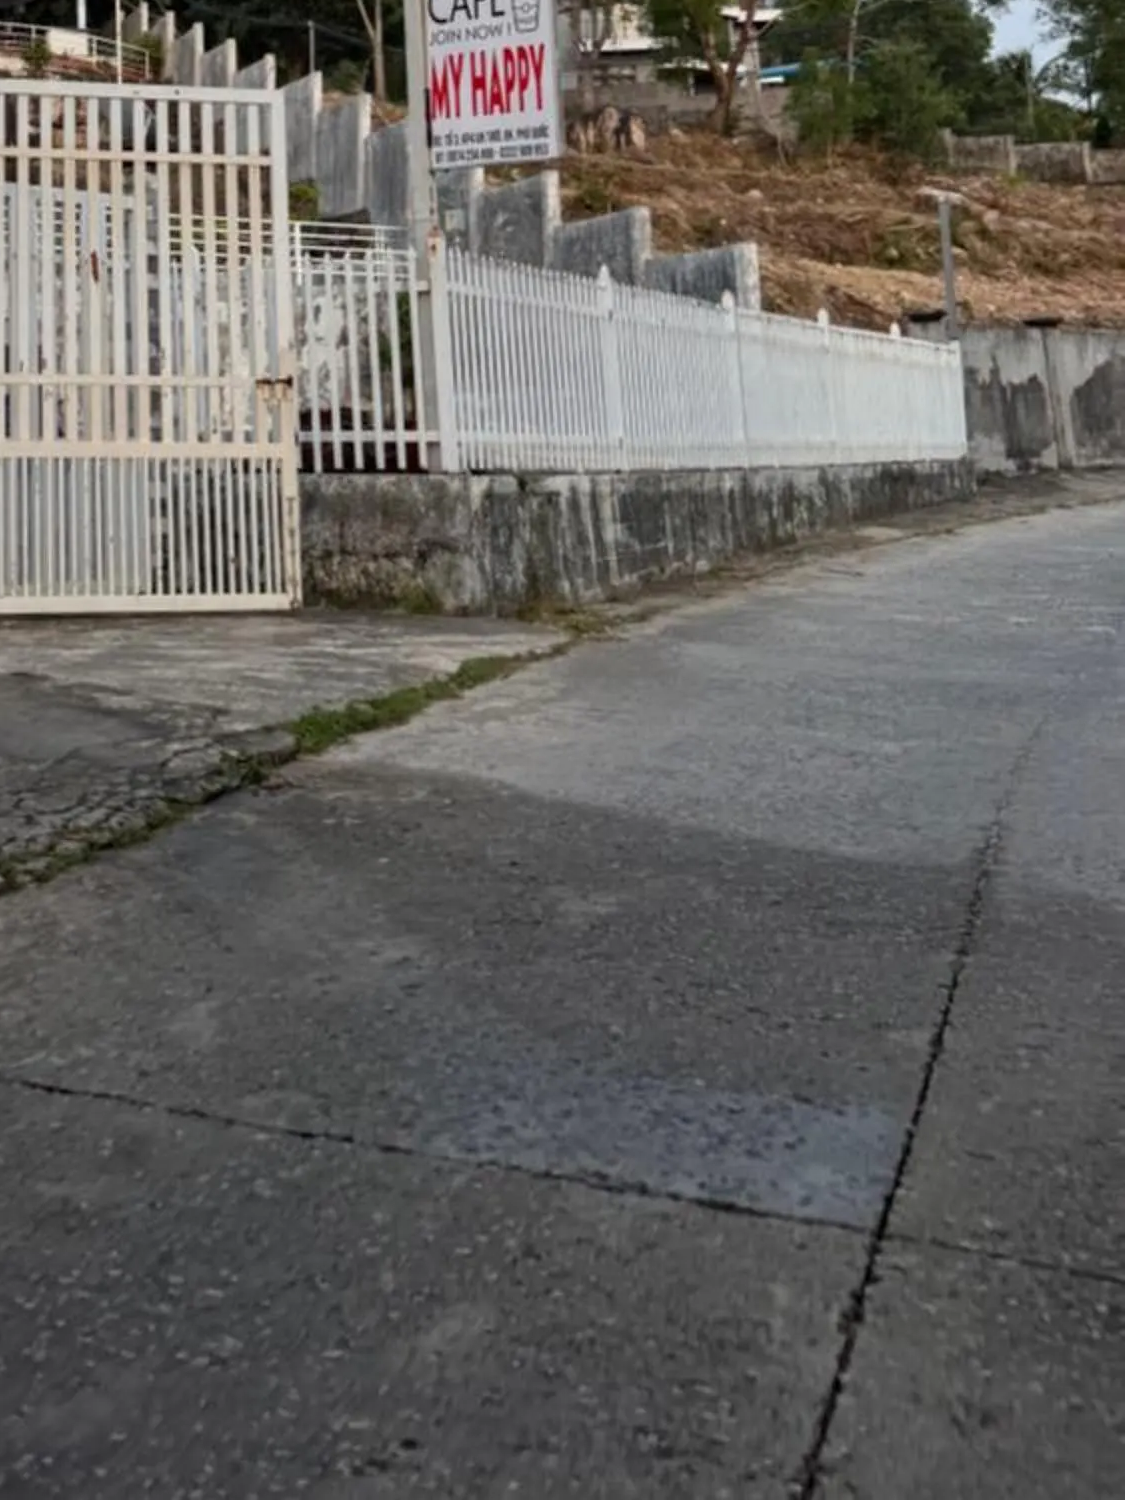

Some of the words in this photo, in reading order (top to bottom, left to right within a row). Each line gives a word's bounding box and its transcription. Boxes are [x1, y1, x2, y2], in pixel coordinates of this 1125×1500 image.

[430, 27, 462, 47] JOIN
[465, 24, 504, 42] NOW
[430, 51, 464, 121] MY
[470, 43, 545, 117] HAPPY
